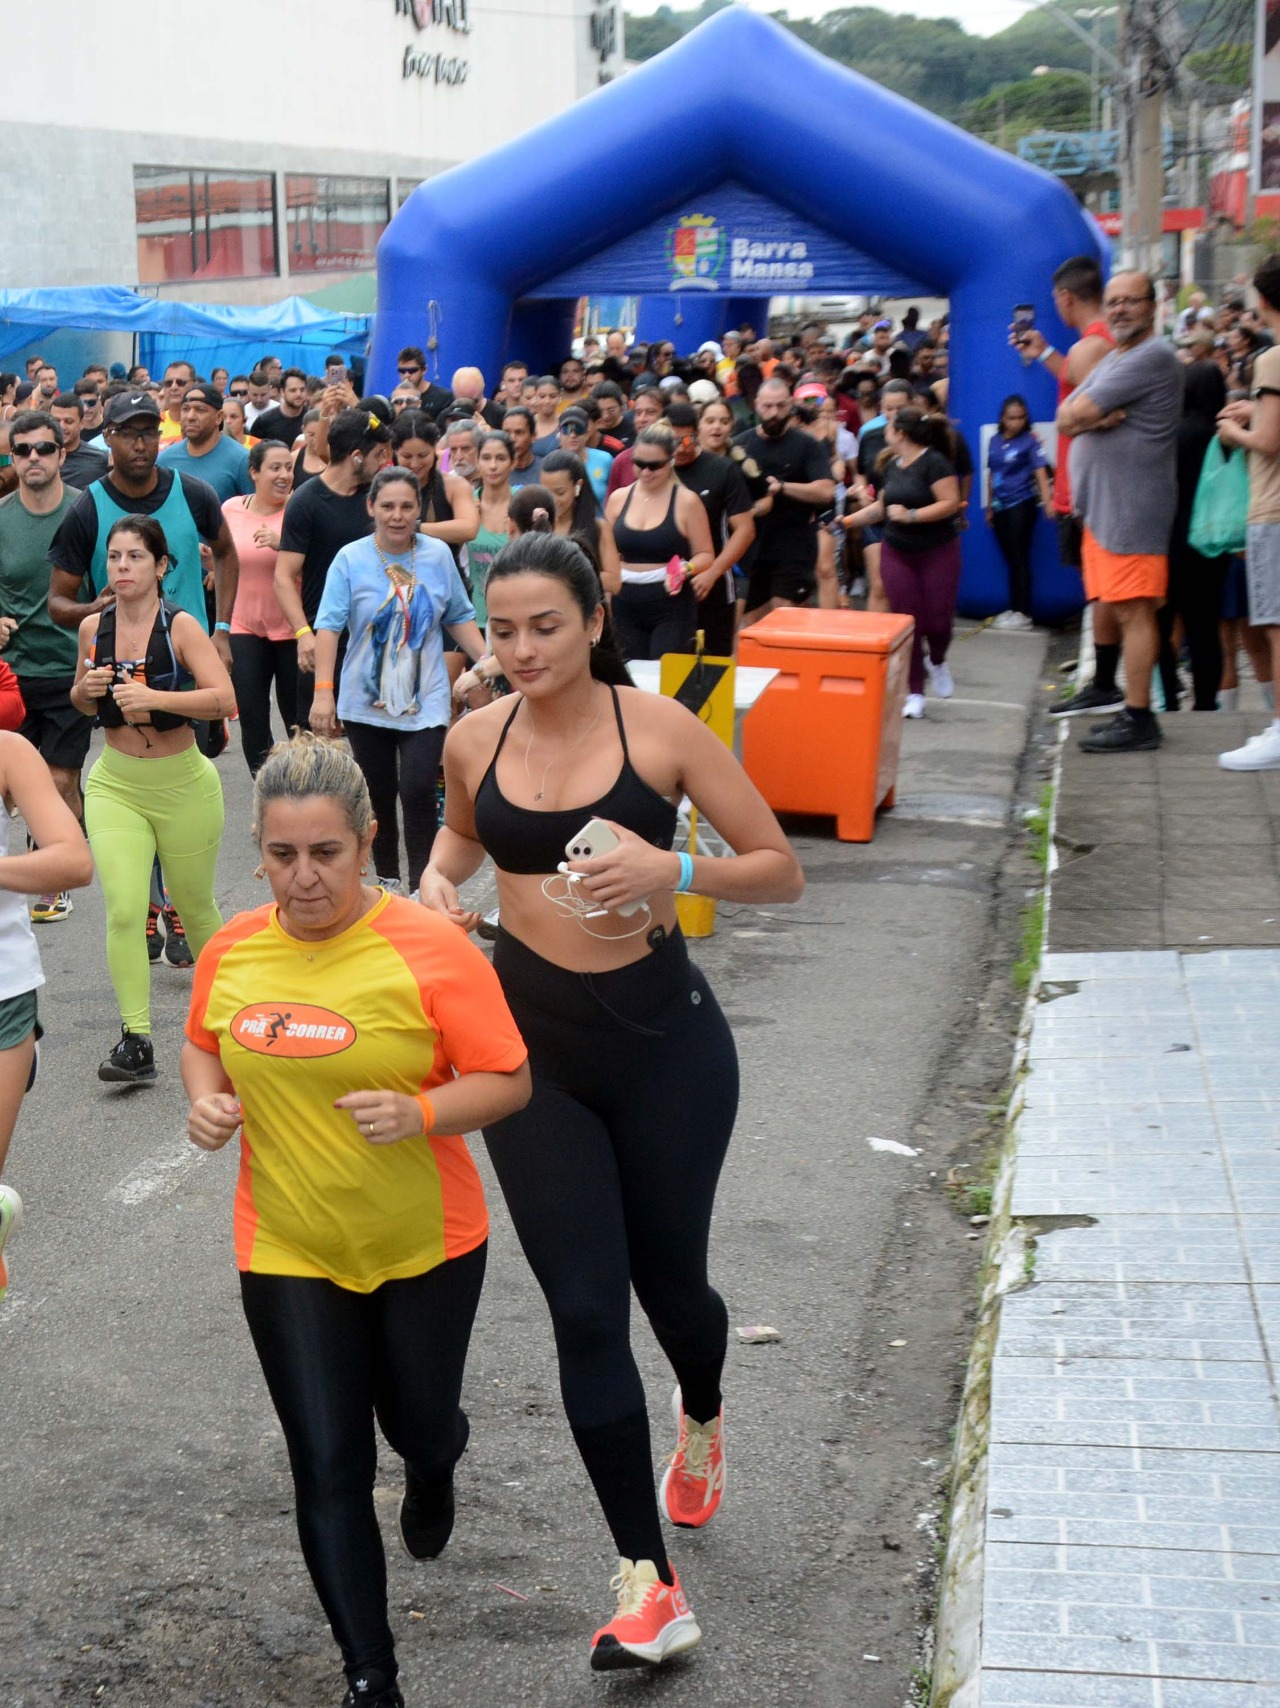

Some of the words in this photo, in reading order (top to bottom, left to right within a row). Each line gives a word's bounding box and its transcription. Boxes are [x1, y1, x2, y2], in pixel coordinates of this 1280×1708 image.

[731, 238, 807, 259] Barra
[731, 258, 814, 278] Mansa
[285, 1023, 347, 1041] CORRER
